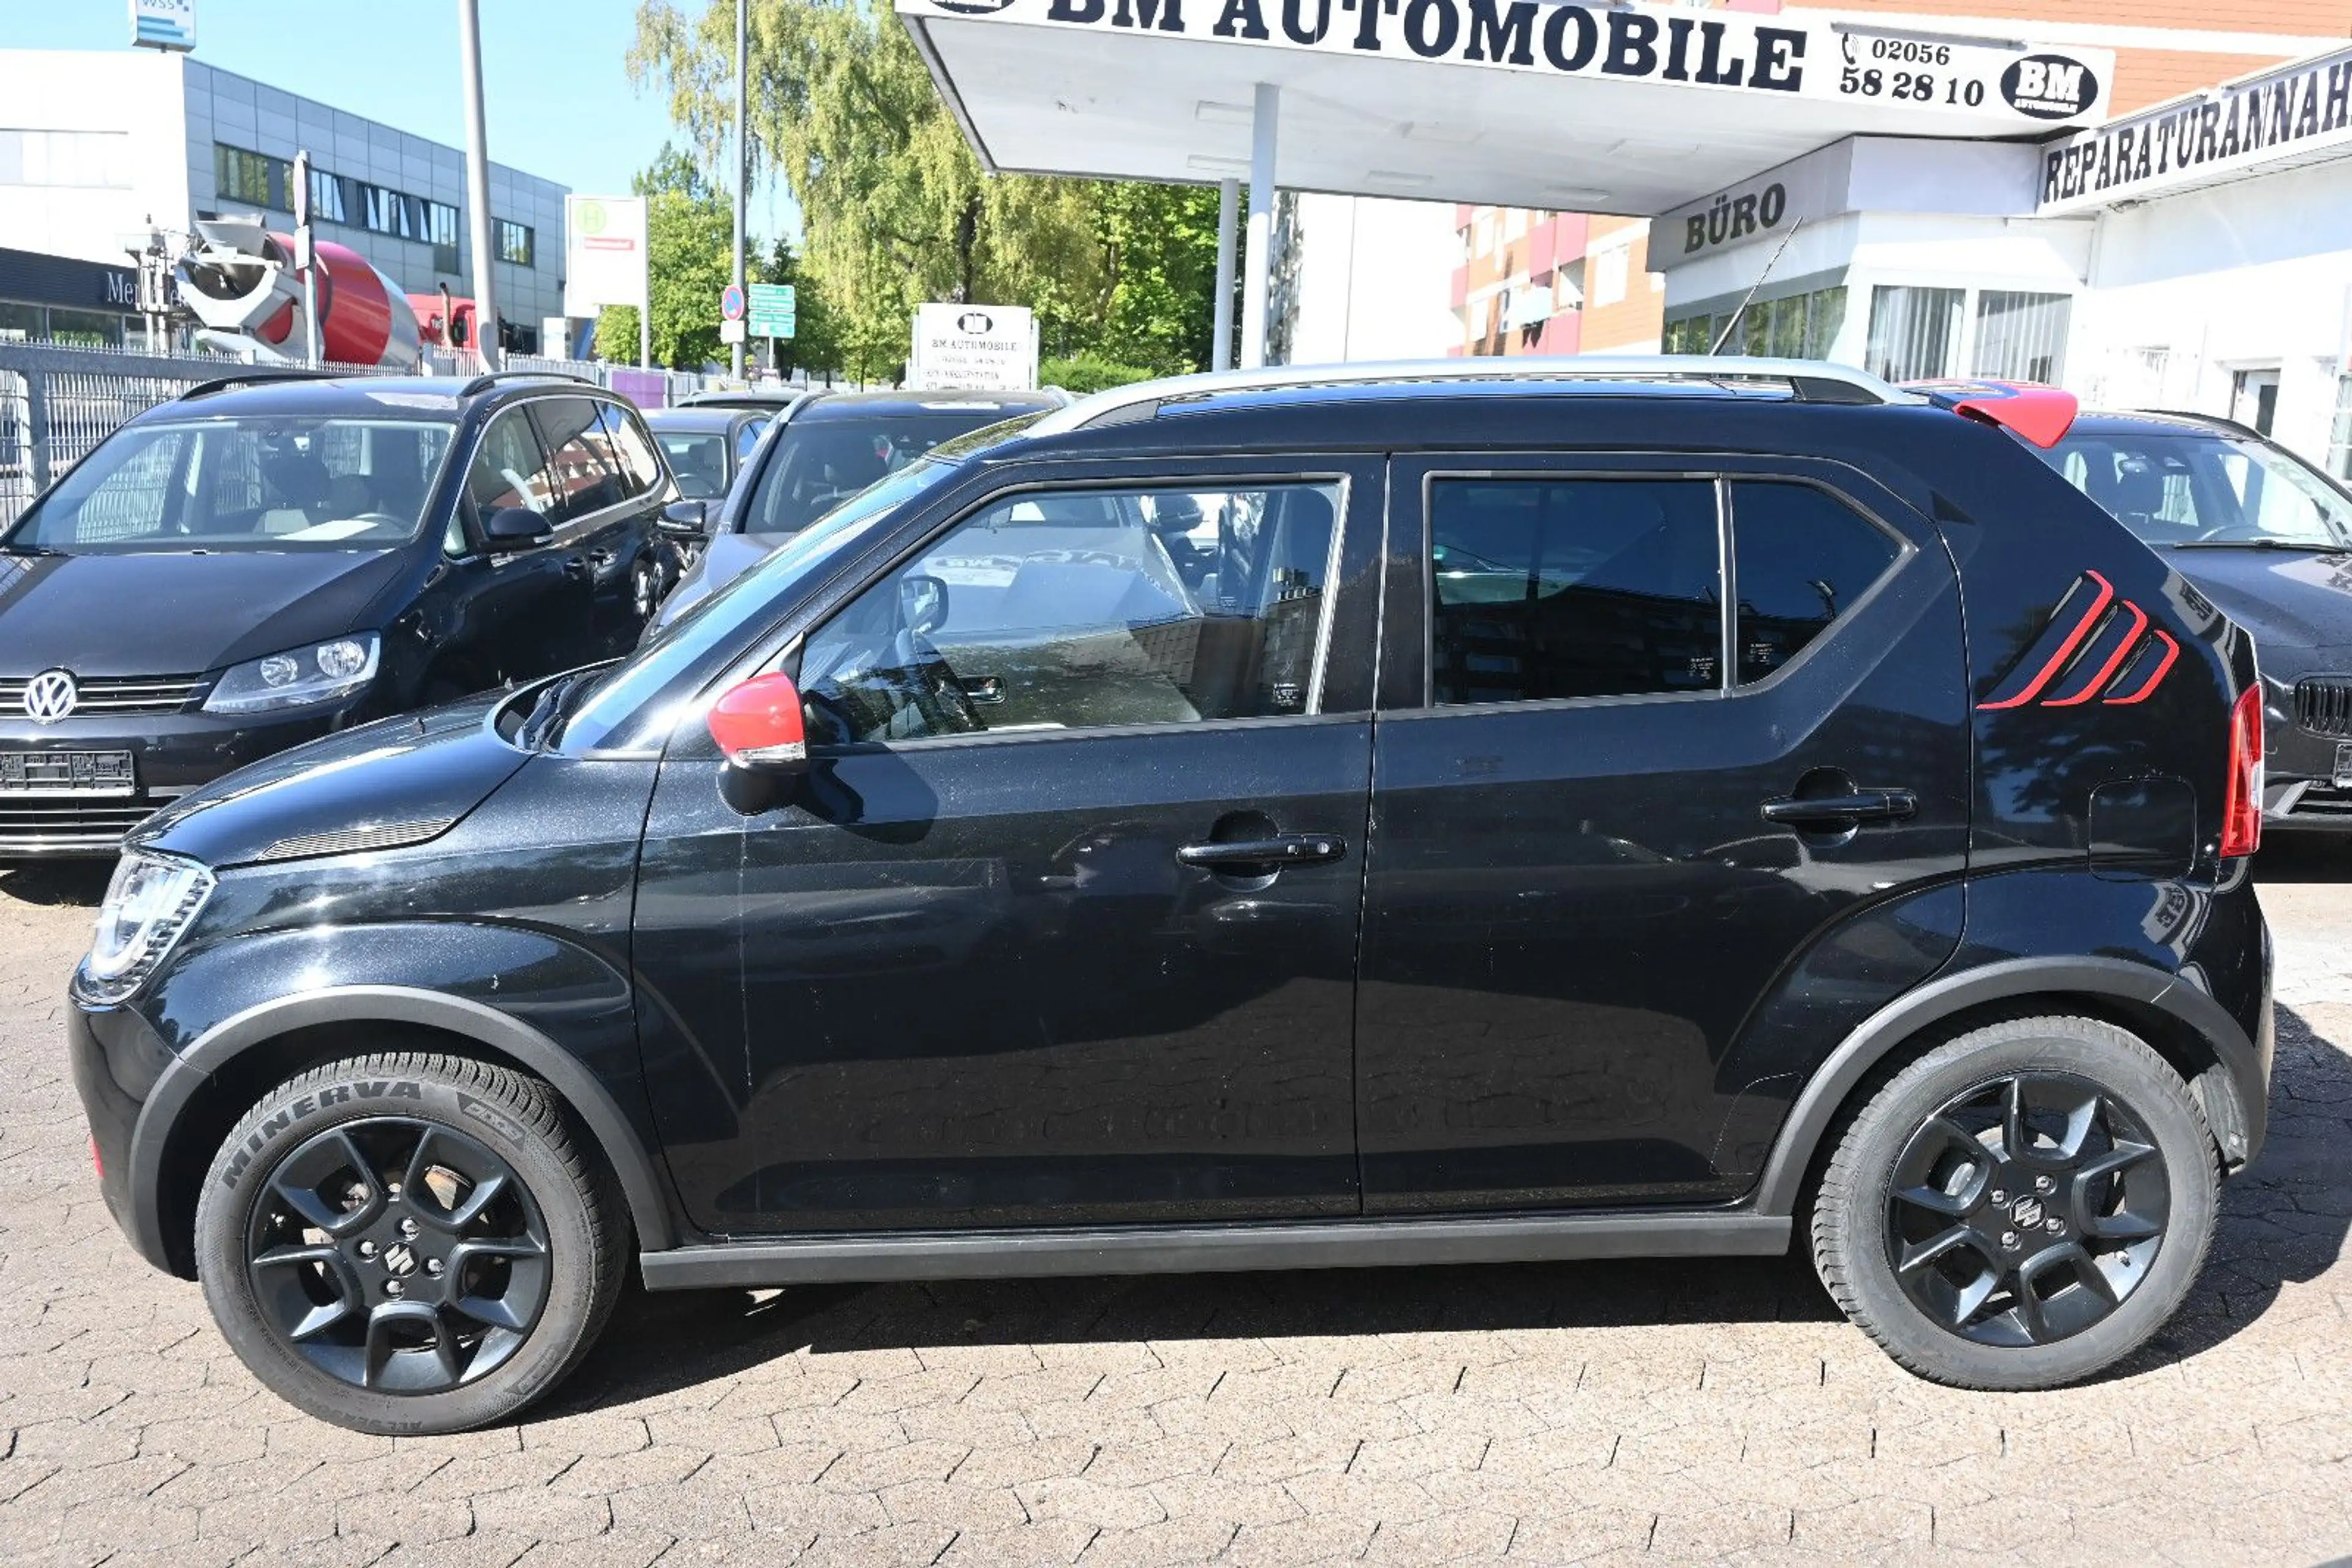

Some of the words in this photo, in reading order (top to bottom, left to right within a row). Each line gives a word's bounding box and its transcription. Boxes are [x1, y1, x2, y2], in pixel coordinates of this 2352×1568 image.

[1213, 0, 1807, 92] AUTOMOBILE
[1872, 39, 1950, 66] 02056
[2015, 60, 2084, 102] BM
[1839, 67, 1883, 96] 58
[1892, 72, 1934, 102] 28
[1945, 78, 1985, 107] 10
[2043, 60, 2352, 203] REPARATURANNAH
[1684, 183, 1786, 254] BÜRO
[222, 1081, 421, 1190] MINERVA
